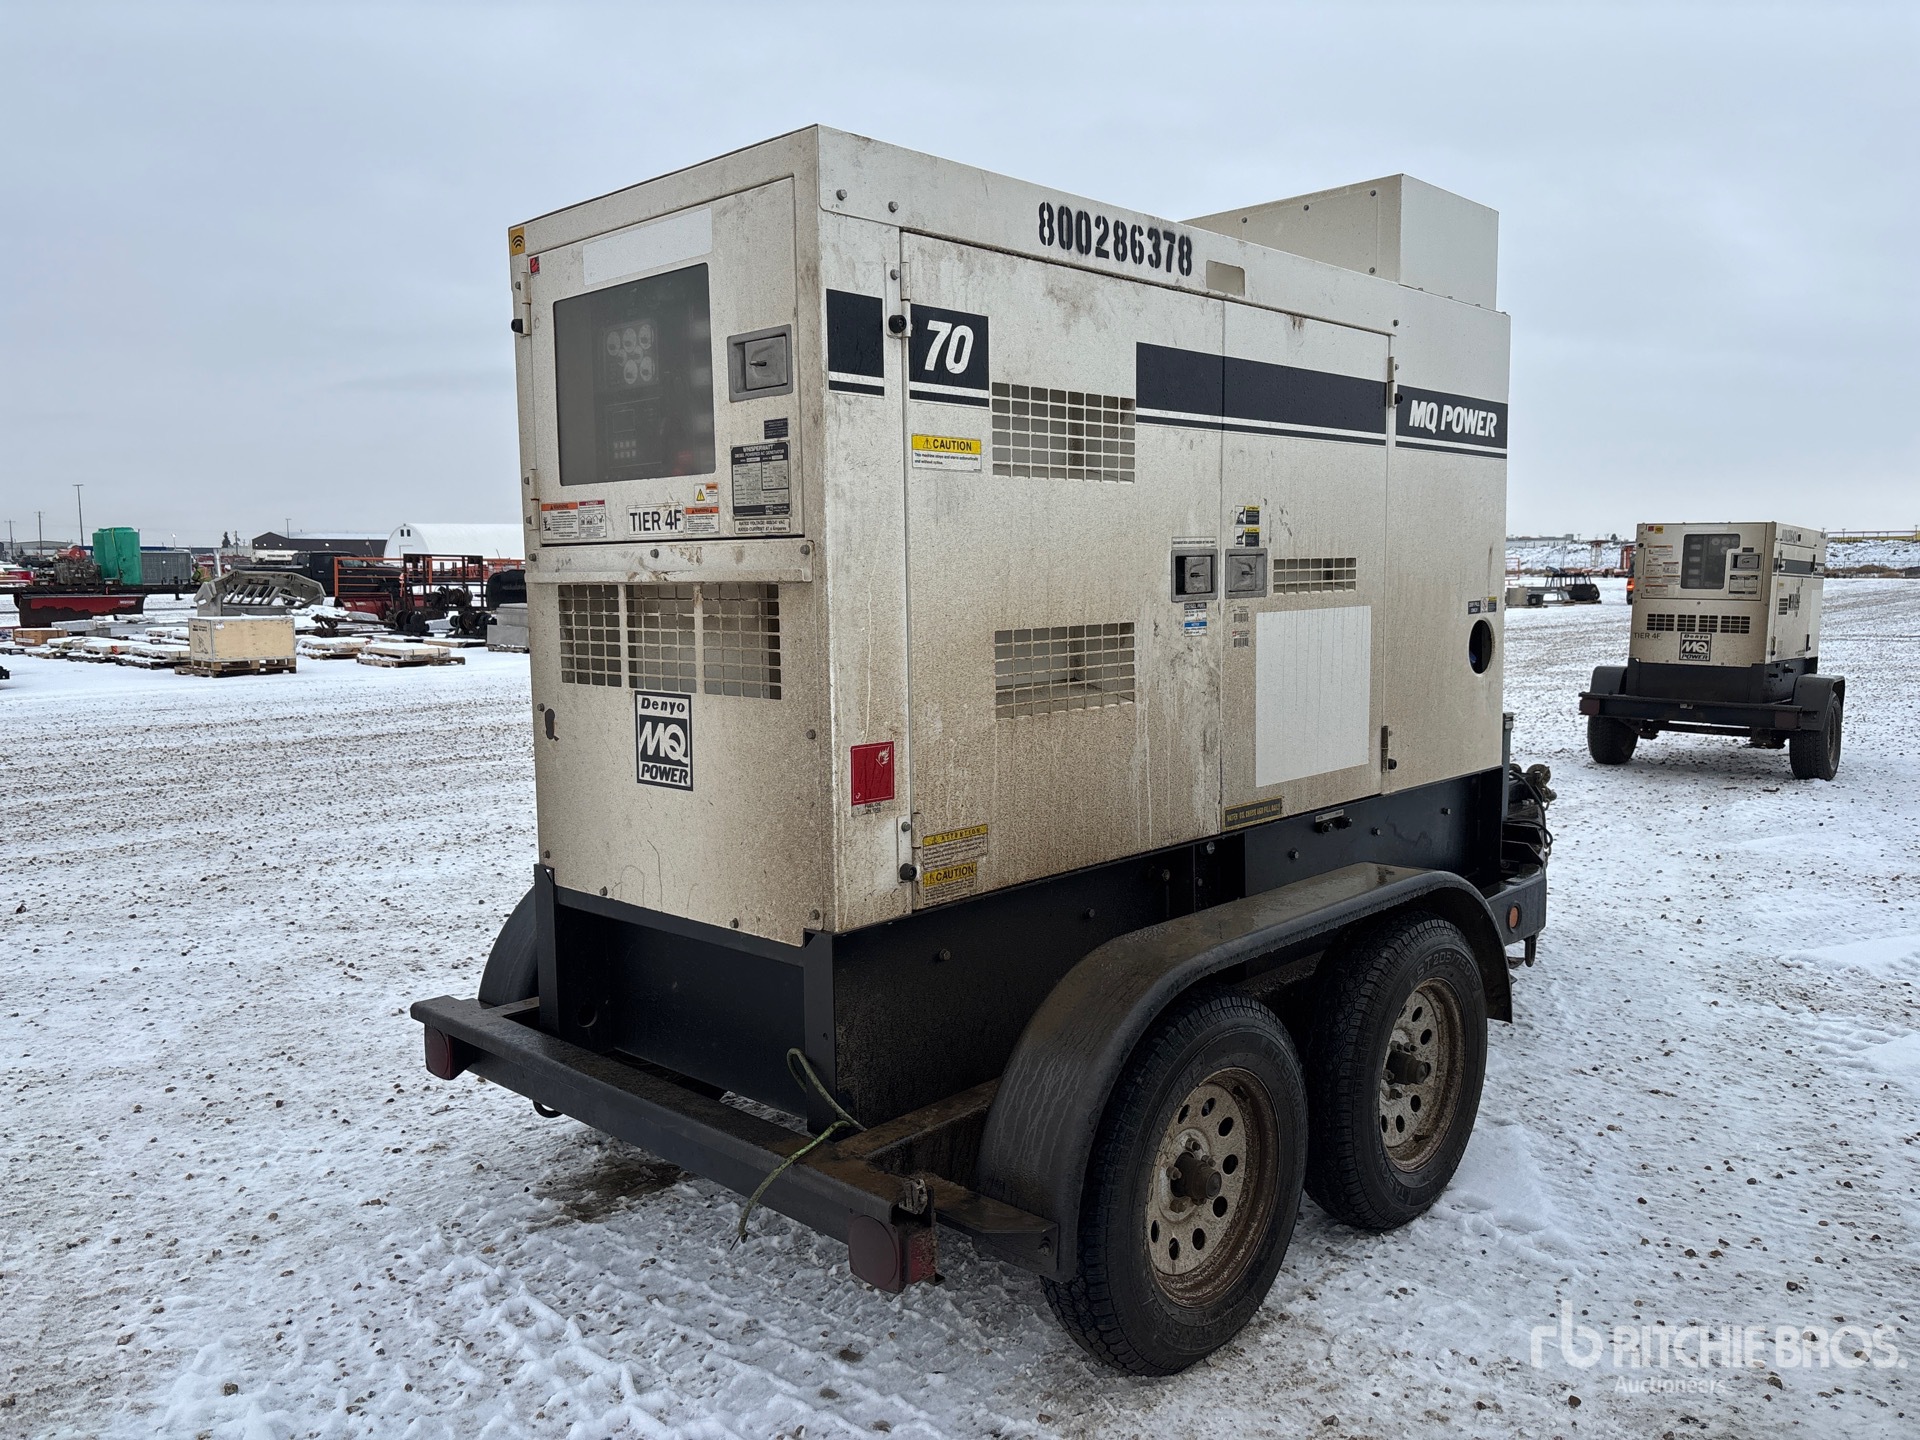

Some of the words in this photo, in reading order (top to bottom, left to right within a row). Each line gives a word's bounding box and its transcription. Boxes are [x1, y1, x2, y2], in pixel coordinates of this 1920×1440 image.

[1038, 201, 1193, 277] 800286378
[924, 319, 974, 375] 70
[1409, 400, 1438, 434] MQ
[1440, 404, 1497, 438] POWER
[933, 439, 972, 451] CAUTION
[630, 511, 661, 532] TIER
[664, 510, 682, 531] 4F
[1634, 632, 1650, 640] TIER
[1651, 632, 1661, 640] 4F
[1681, 640, 1709, 654] MQ
[641, 697, 686, 715] Denyo
[639, 721, 689, 765] MQ
[641, 763, 688, 785] POWER
[935, 866, 973, 882] CAUTION
